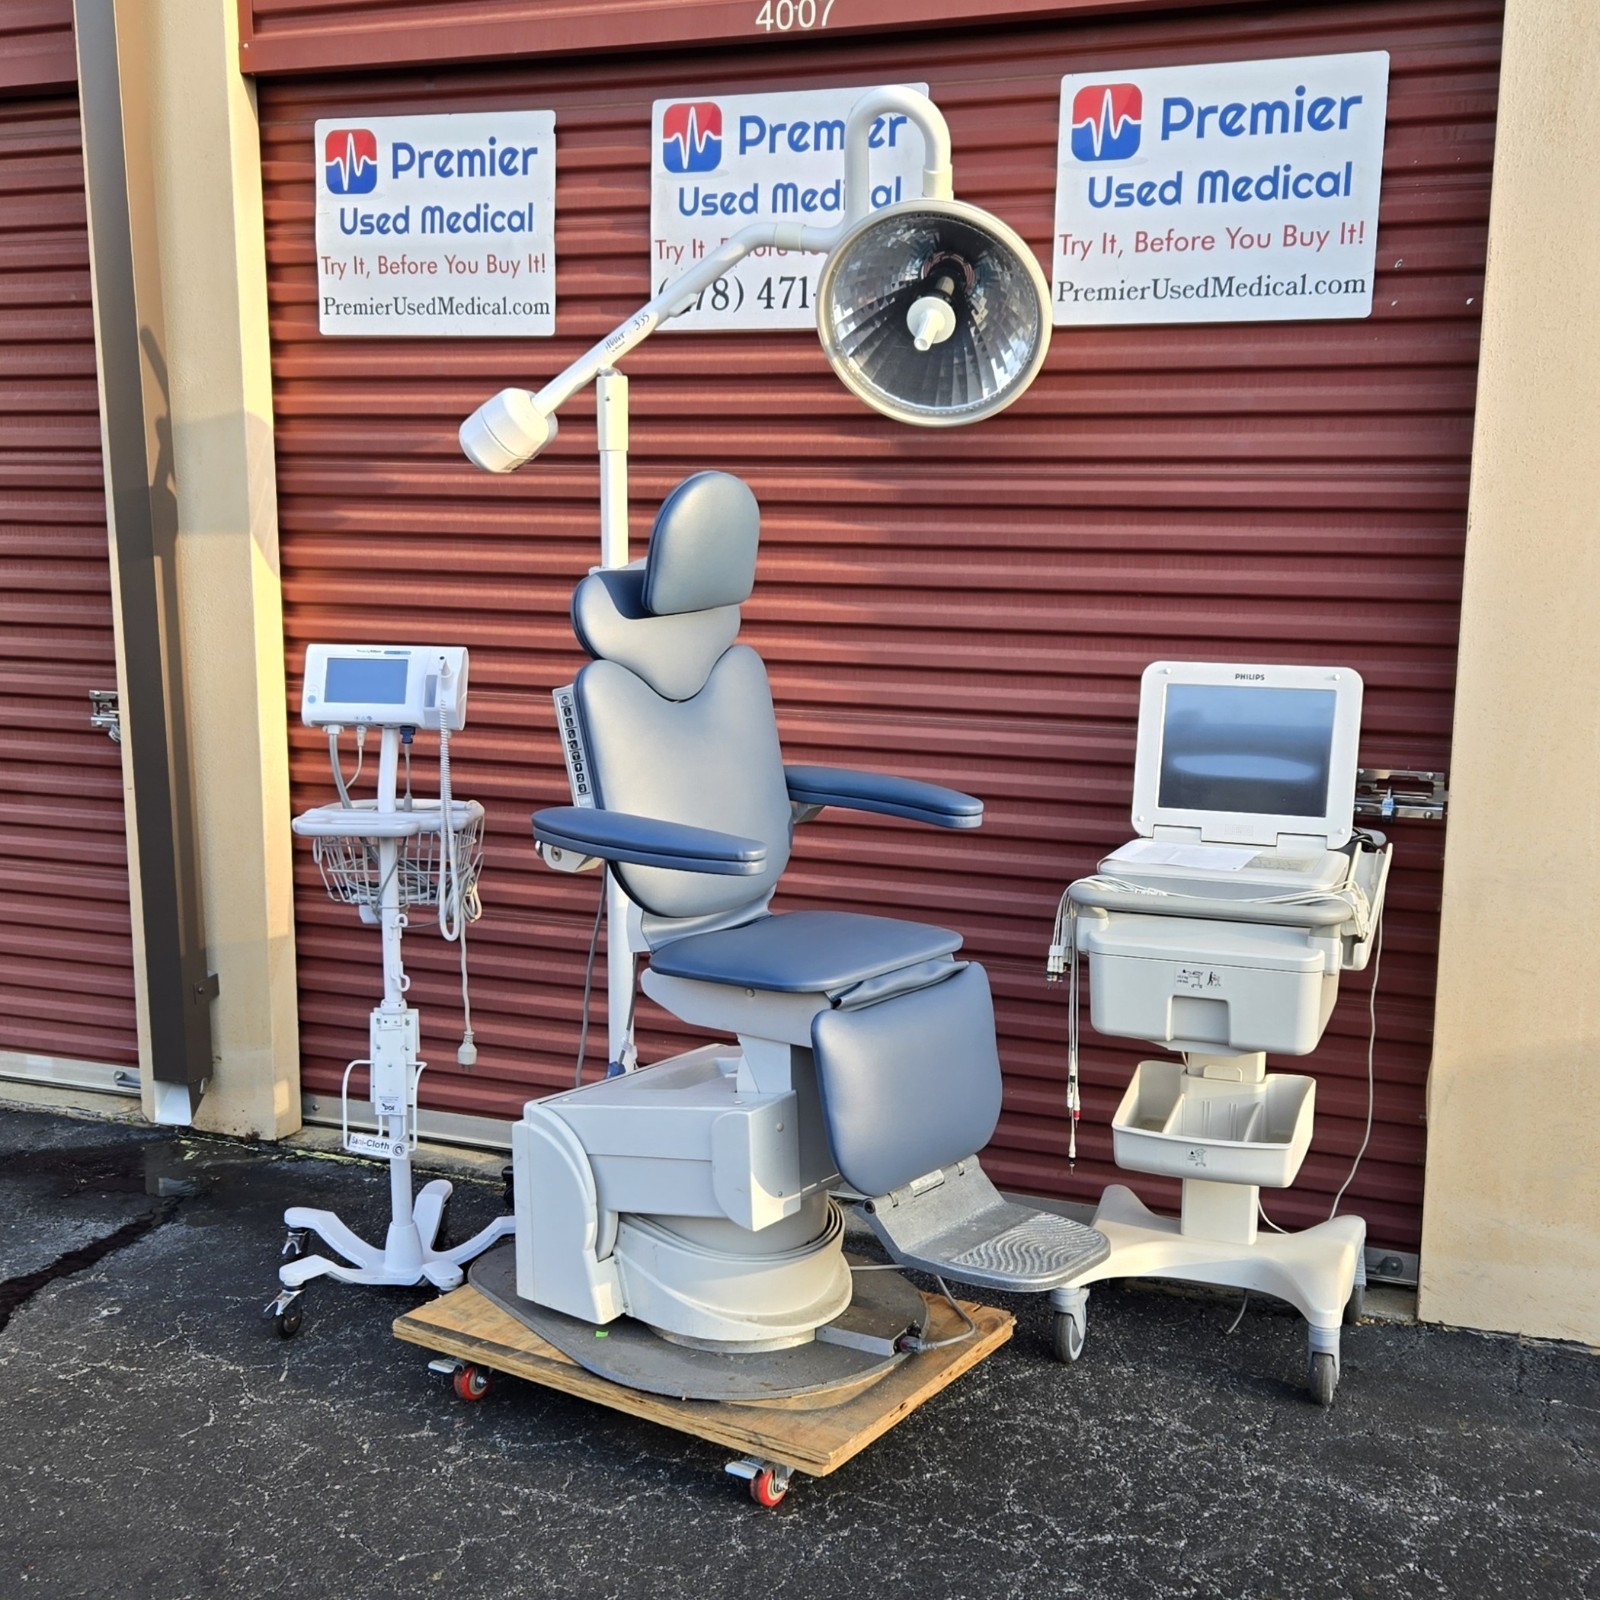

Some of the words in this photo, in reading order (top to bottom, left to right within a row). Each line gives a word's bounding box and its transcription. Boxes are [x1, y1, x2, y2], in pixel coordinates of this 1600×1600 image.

[755, 0, 835, 31] 4007
[1161, 84, 1363, 141] Premier
[739, 114, 908, 155] Premer
[391, 136, 539, 179] Premier
[678, 182, 759, 216] Used
[771, 176, 902, 214] Medal
[1088, 170, 1184, 209] Used
[1197, 161, 1353, 204] Medical
[340, 205, 410, 235] Used
[421, 202, 534, 234] Medical
[655, 239, 685, 265] Try
[1058, 233, 1093, 261] Try
[1101, 232, 1124, 258] It,
[1135, 229, 1215, 253] Before
[1225, 226, 1272, 249] You
[1282, 224, 1330, 252] Buy
[1340, 221, 1365, 245] It!
[321, 256, 347, 280] Try
[353, 255, 371, 279] It,
[378, 254, 438, 276] Before
[444, 254, 479, 275] You
[486, 253, 521, 278] Buy
[528, 252, 547, 273] It!
[1057, 274, 1366, 302] PremierUsedMedical.com
[323, 296, 551, 316] PremierUsedMedical.com
[1234, 673, 1265, 681] PHILIPS
